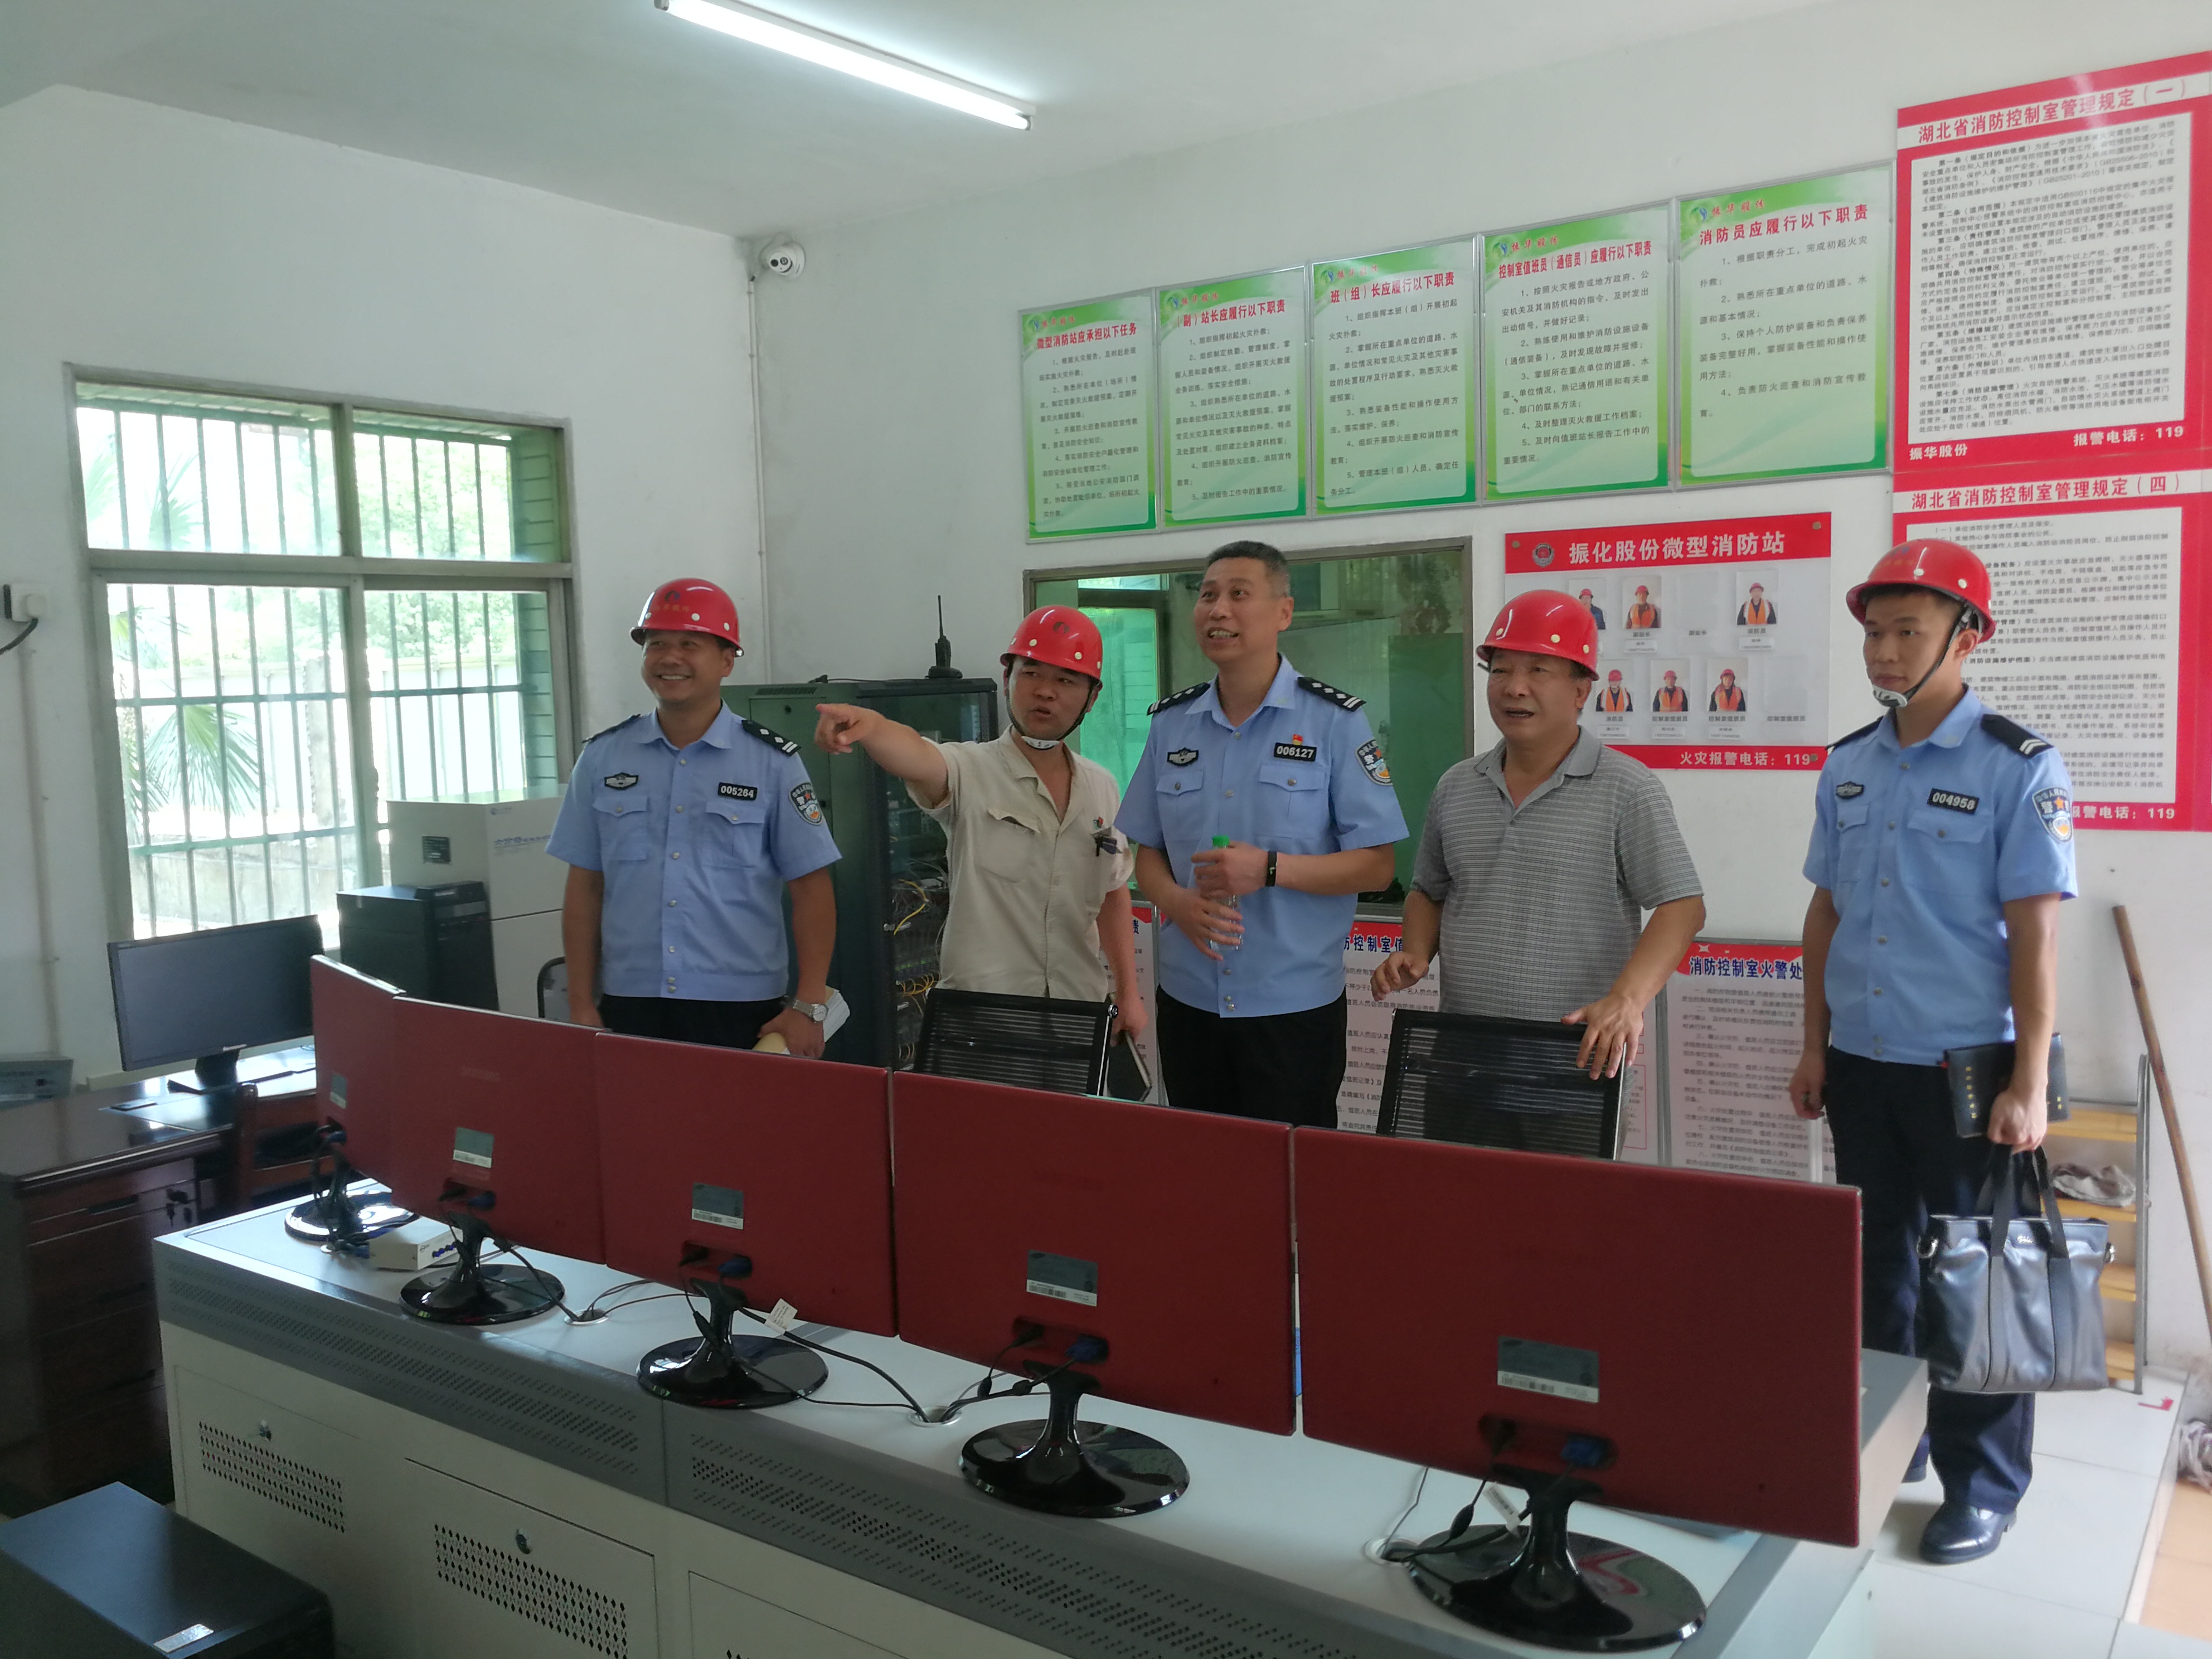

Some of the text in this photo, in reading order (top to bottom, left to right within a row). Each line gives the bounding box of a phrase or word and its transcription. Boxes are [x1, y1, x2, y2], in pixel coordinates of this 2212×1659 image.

[1919, 77, 2185, 145] 湖北省消防控制室管理规定（一）
[1700, 203, 1867, 246] 消防员应履行以下职责
[1498, 240, 1651, 279] 控制室值班员（通信员）应履行以下职责
[1331, 271, 1454, 303] 班（组）长应履行以下职责
[1177, 299, 1284, 328] （副）站长应履行以下职责
[1036, 322, 1137, 350] 微型消防站应承担以下任务
[1909, 443, 1967, 461] 振华股份
[1912, 473, 2179, 511] 湖北省消防控制室管理规定（四）
[1569, 531, 1785, 564] 振化股份微型消防站
[1277, 746, 1314, 759] 006127
[1680, 750, 1810, 767] 火灾报警电话：119
[720, 785, 754, 798] 005264
[1932, 793, 1976, 811] 004958
[1690, 956, 1802, 981] 消防控制室火警处
